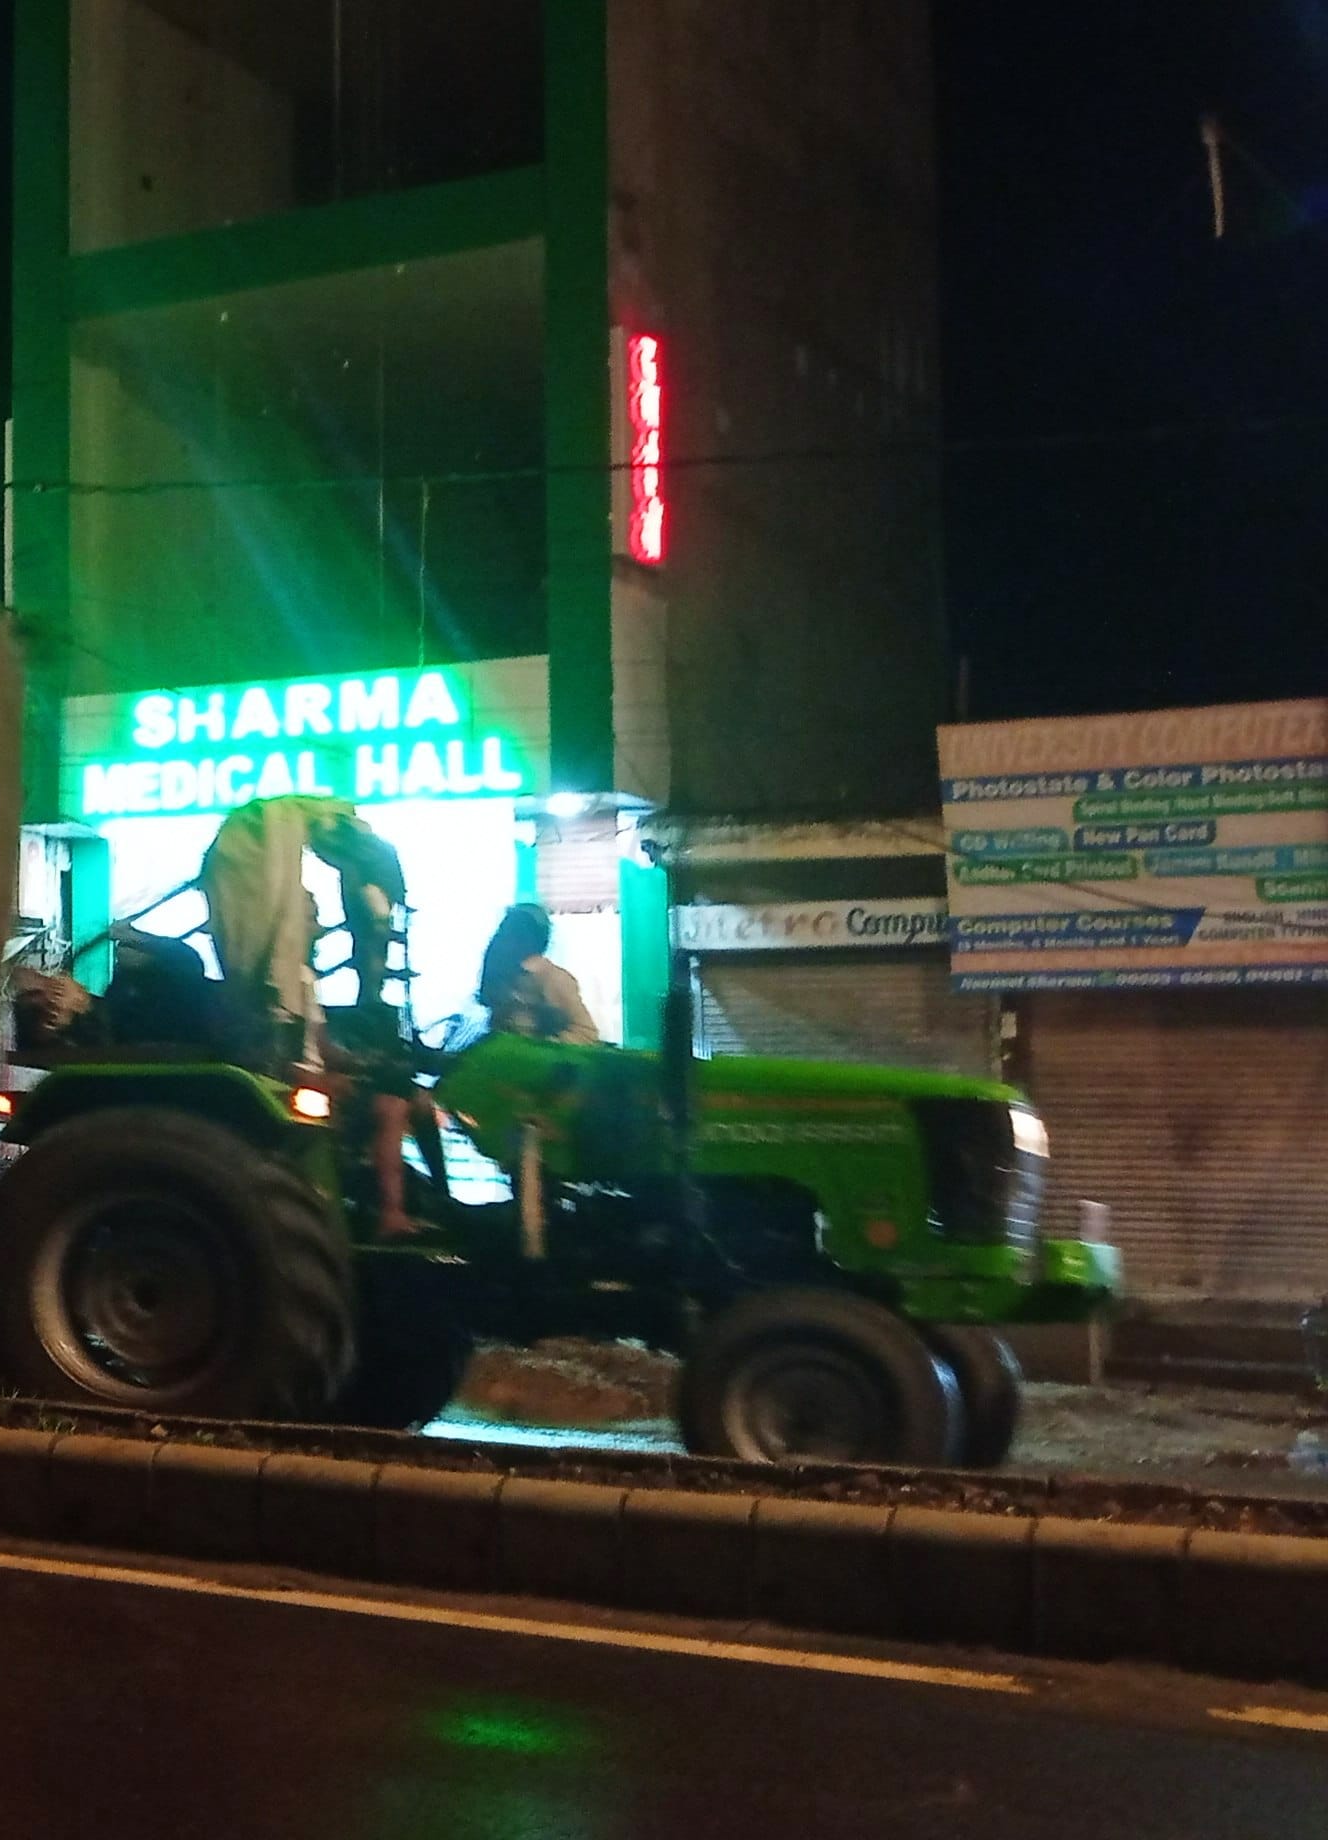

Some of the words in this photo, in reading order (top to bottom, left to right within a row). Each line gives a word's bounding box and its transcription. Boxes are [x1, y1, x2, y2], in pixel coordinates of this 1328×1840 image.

[132, 671, 460, 749] SHARMA
[82, 750, 333, 815] MEDICAL
[355, 737, 522, 797] HALL
[953, 776, 1088, 800] Photostate
[1097, 773, 1114, 790] &
[1125, 767, 1193, 789] Color
[1083, 831, 1121, 845] New
[1126, 825, 1160, 842] Pan
[1165, 823, 1209, 841] Card
[957, 917, 1070, 937] Computer
[1076, 912, 1174, 931] Courses
